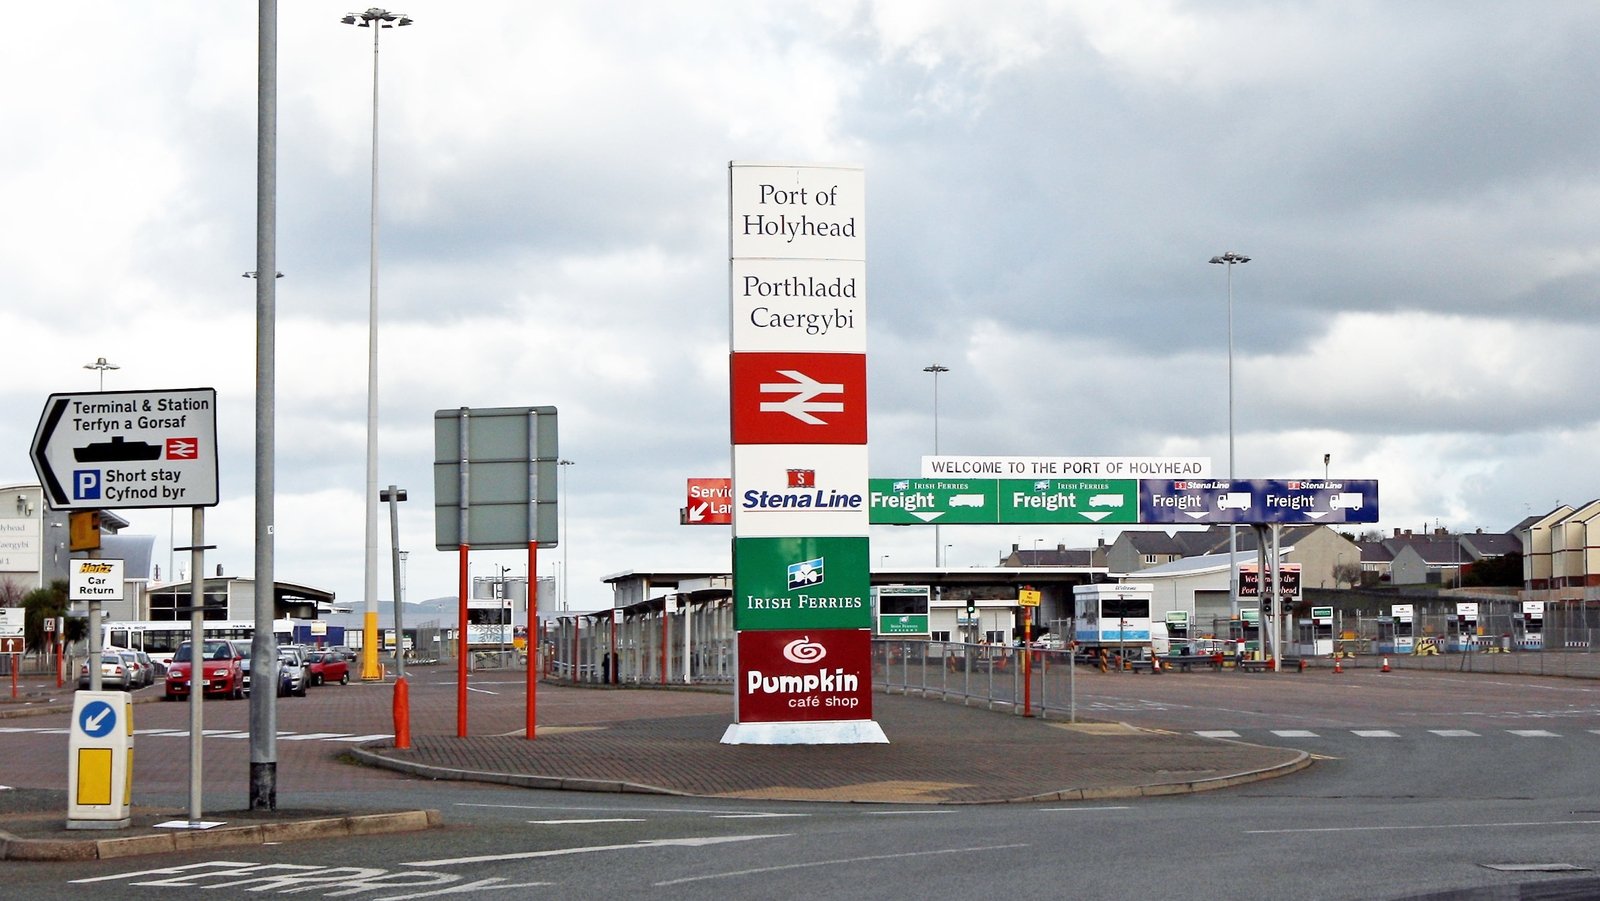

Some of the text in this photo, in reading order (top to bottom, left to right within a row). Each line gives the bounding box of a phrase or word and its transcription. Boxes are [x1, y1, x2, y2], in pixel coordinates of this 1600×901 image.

[759, 184, 837, 206] Port of
[742, 214, 856, 243] Holyhead
[743, 275, 856, 298] Porthladd
[750, 307, 854, 335] Caergybi
[73, 398, 209, 414] Terminal & Station
[73, 415, 186, 432] Terfyn a Gorsaf
[105, 468, 182, 483] Short stay
[932, 462, 1202, 474] WELCOME TO THE PORT OF HOLYHEAD
[79, 472, 97, 498] P
[105, 485, 186, 501] Cyfnod byr
[871, 492, 935, 512] Freight
[1013, 492, 1076, 512] Freight
[1152, 494, 1202, 509] Freight
[1266, 494, 1315, 509] Freight
[79, 562, 115, 574] Hertz
[88, 576, 106, 585] Car
[79, 586, 114, 595] Return
[747, 594, 862, 609] IRISH FERRIES
[748, 668, 859, 694] Pumpkin
[788, 695, 860, 709] café shop
